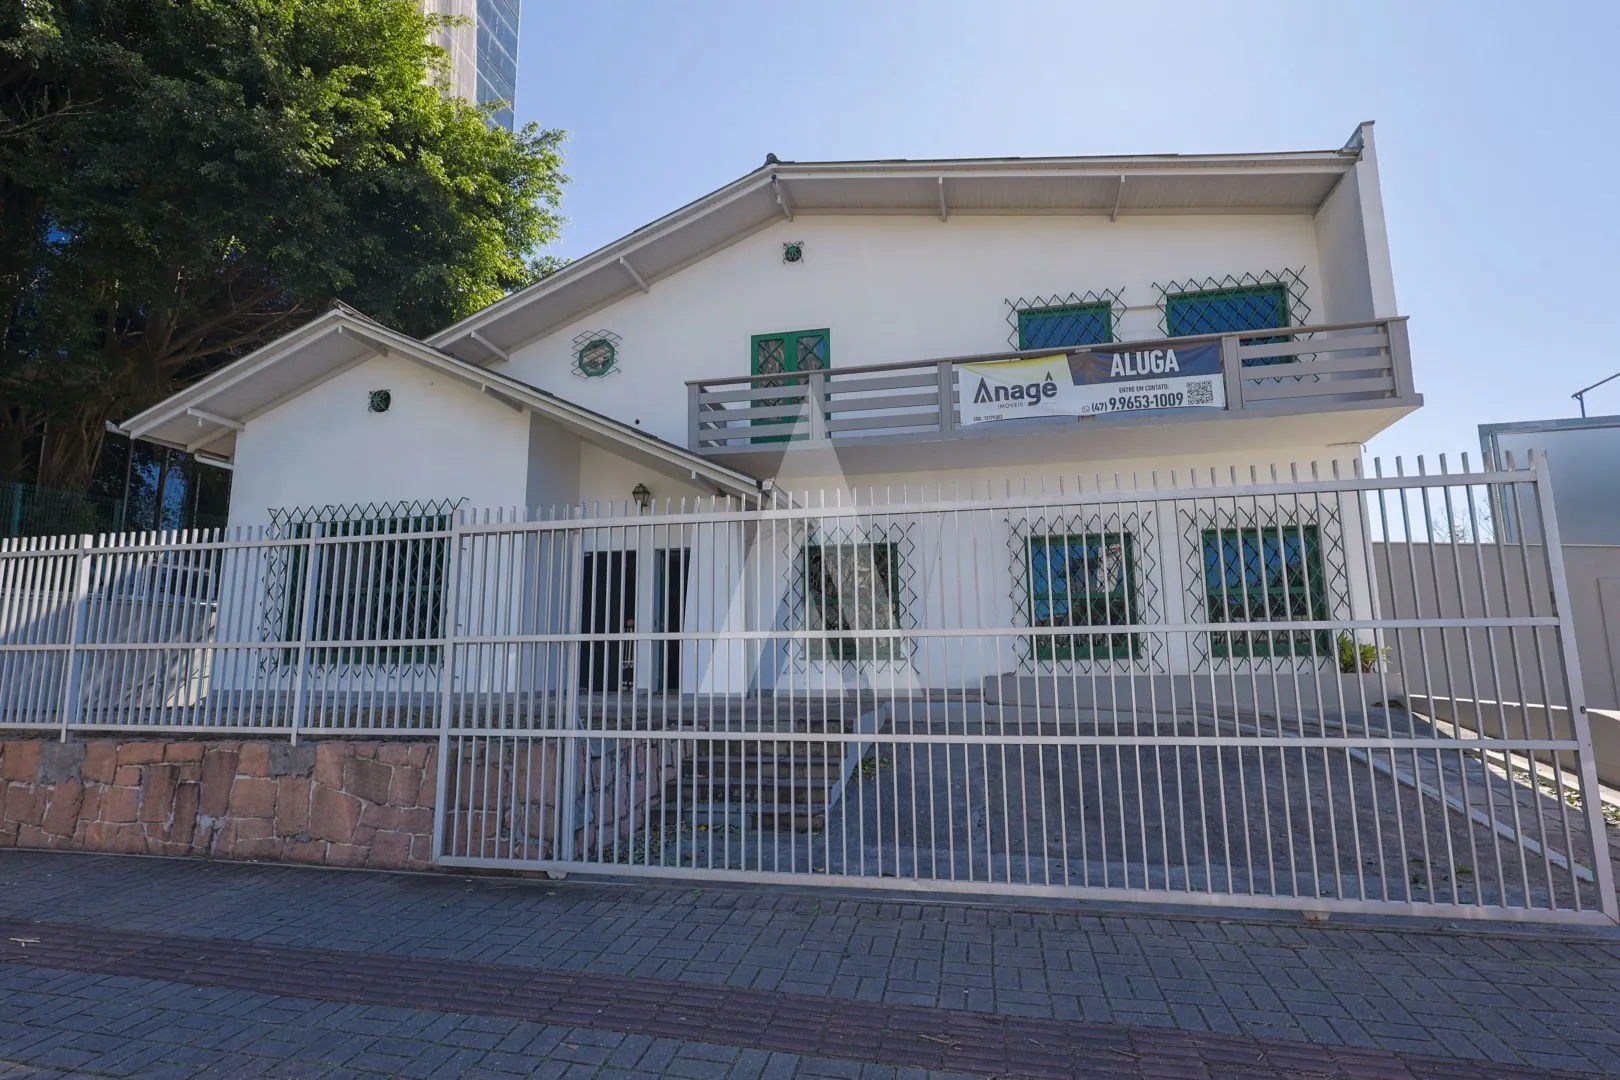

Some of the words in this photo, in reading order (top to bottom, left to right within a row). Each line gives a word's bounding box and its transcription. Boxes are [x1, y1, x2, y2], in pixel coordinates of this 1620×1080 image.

[1110, 349, 1180, 377] ALUGA
[973, 371, 1058, 407] Anagê
[1145, 383, 1170, 391] CONTATO:
[1091, 402, 1108, 413] (47)
[1109, 392, 1184, 411] 9.9653-1009
